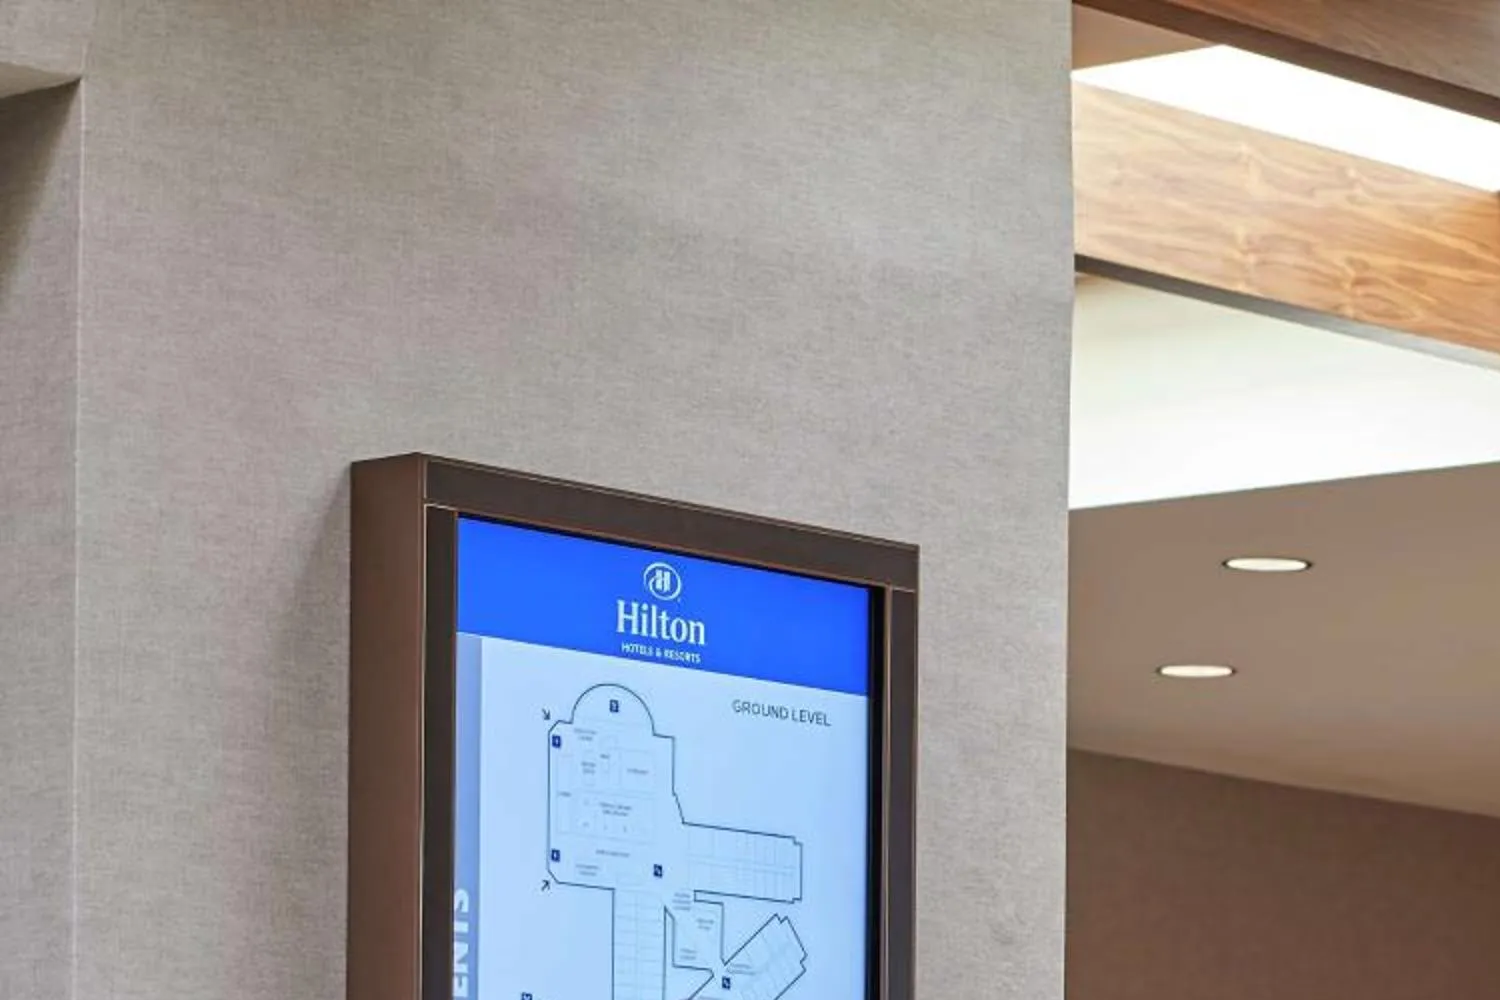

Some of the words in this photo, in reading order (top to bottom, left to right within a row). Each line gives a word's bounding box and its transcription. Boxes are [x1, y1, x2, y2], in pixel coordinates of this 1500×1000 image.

[616, 599, 706, 646] Hilton
[621, 641, 654, 657] HOTELS
[664, 648, 702, 664] RESORTS
[732, 699, 789, 721] GROUND
[791, 708, 832, 727] LEVEL
